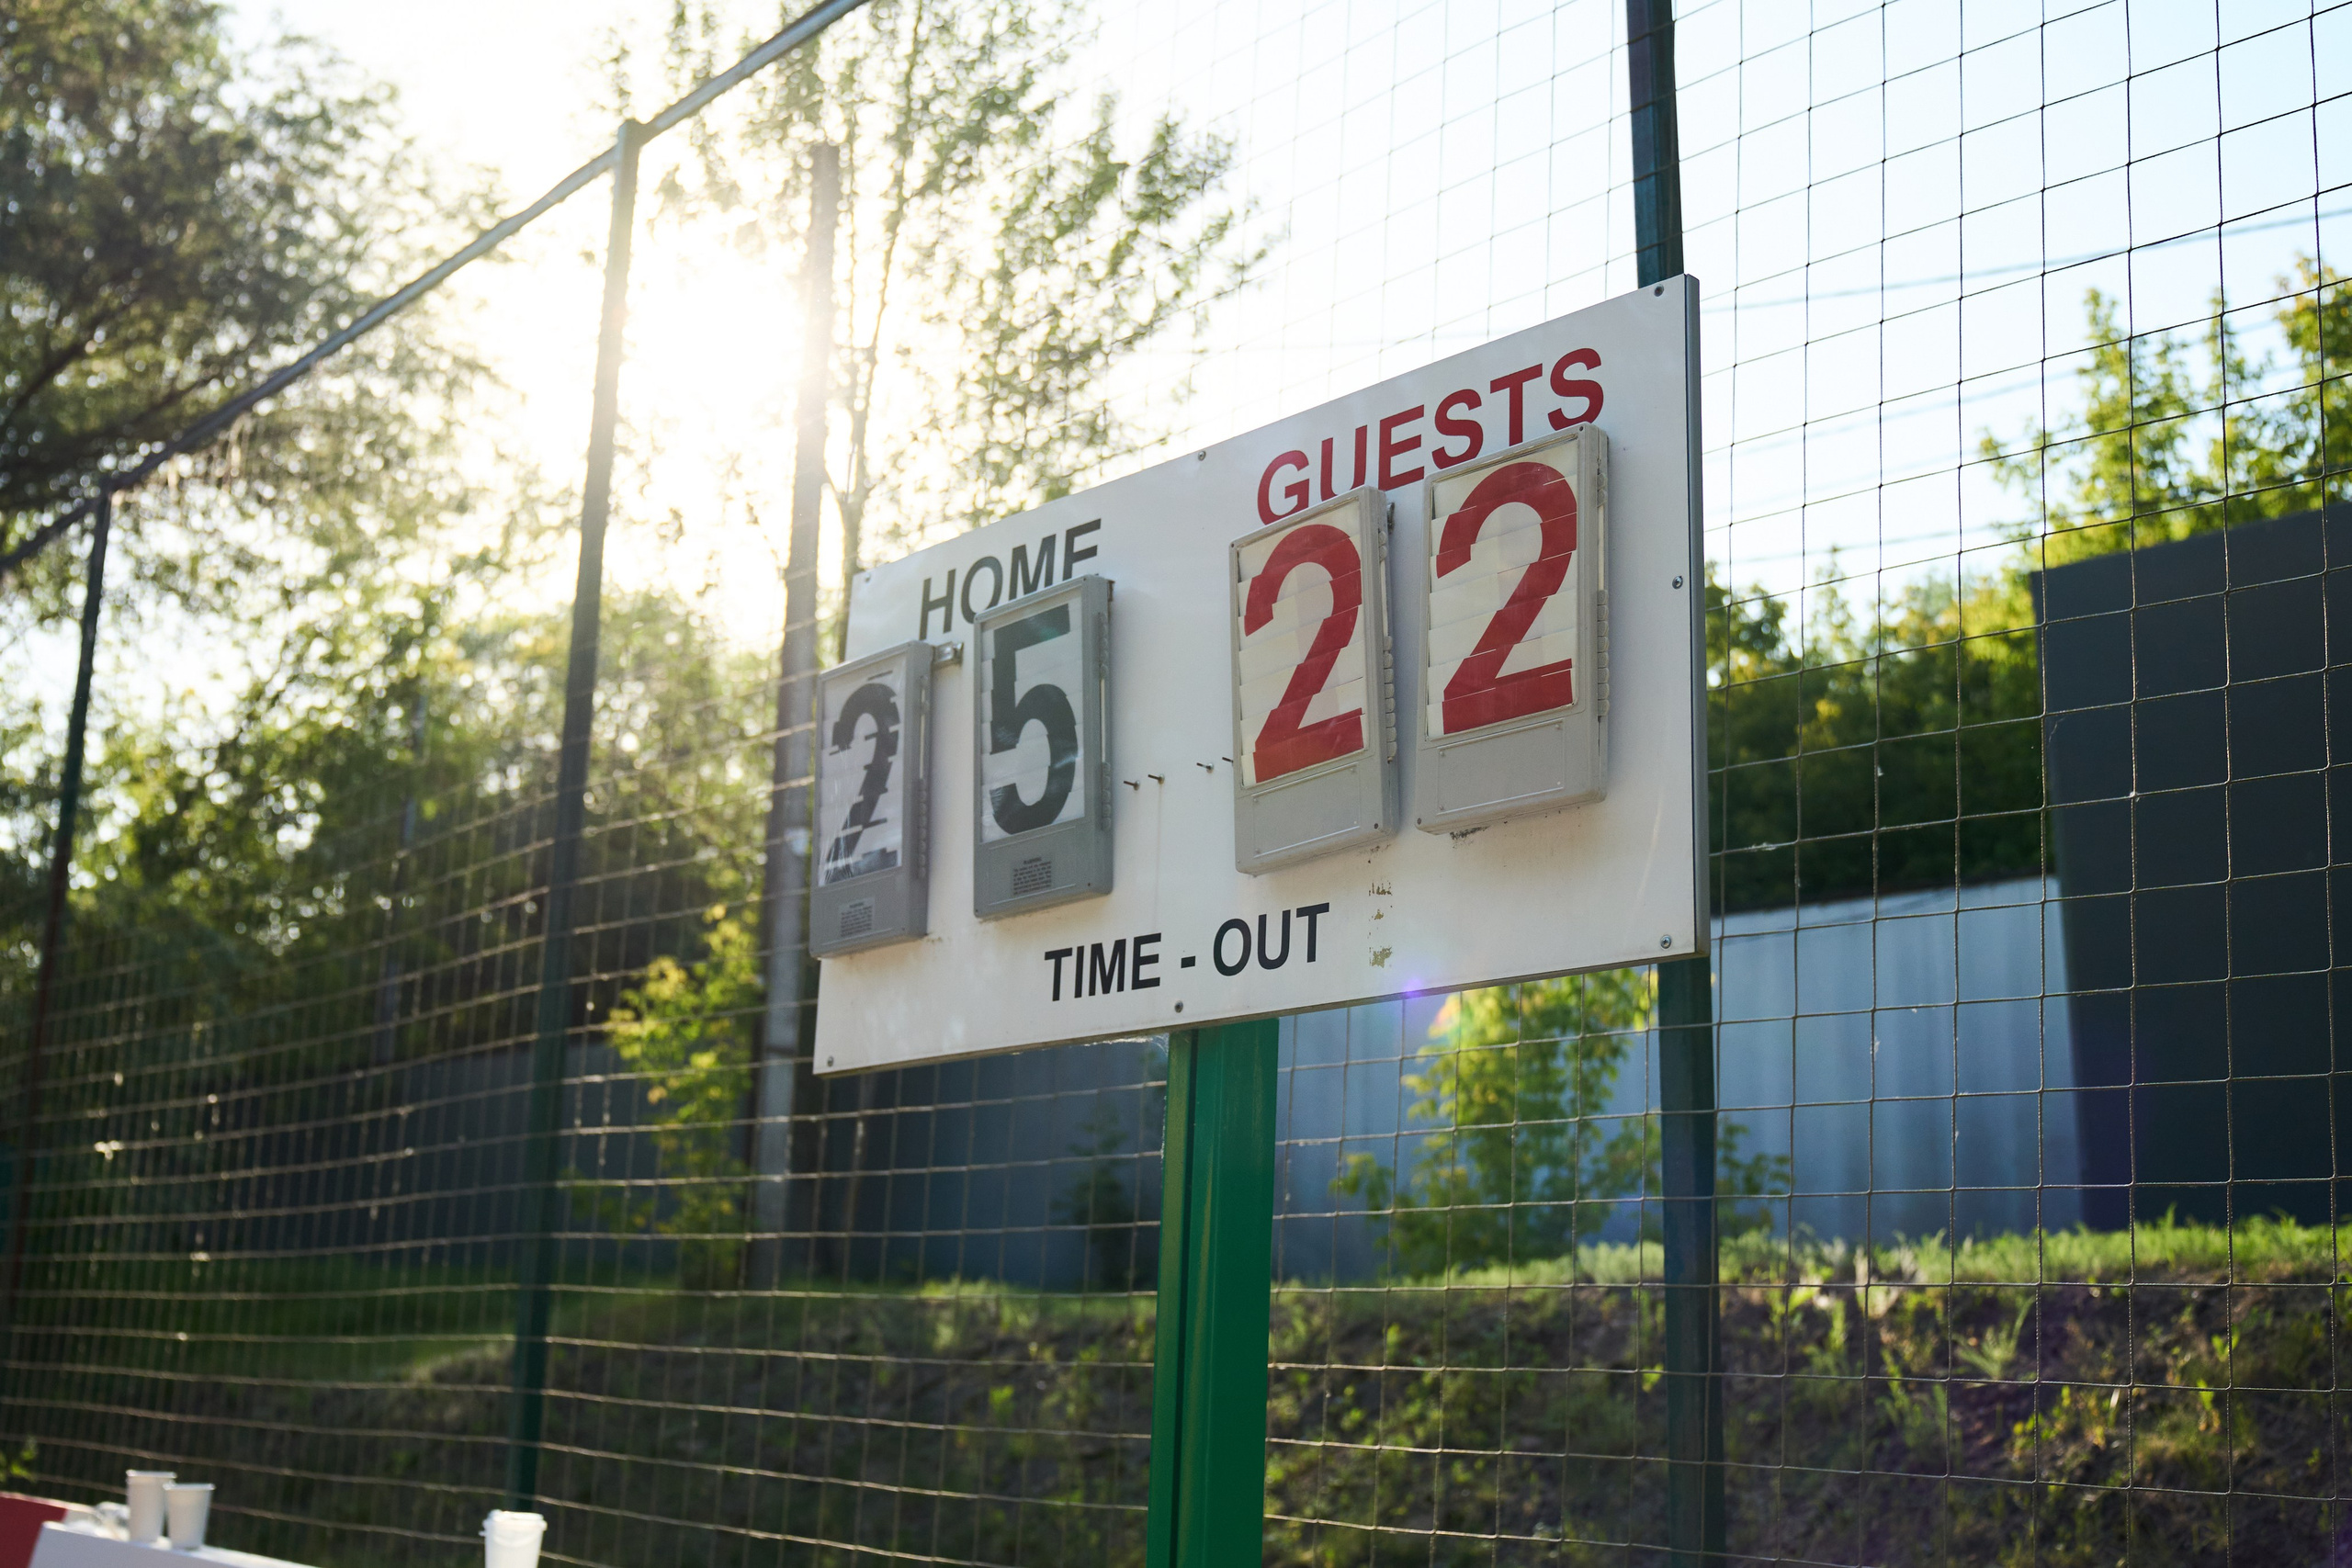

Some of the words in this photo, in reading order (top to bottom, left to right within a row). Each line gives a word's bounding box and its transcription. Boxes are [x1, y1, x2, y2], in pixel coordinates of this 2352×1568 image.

[1257, 347, 1604, 526] GUESTS
[920, 518, 1102, 640] HOME
[1244, 524, 1364, 784] 2
[1436, 461, 1578, 735] 2
[825, 682, 901, 882] 2
[988, 604, 1079, 835] 5
[1044, 932, 1161, 1002] TIME
[1213, 902, 1329, 976] OUT
